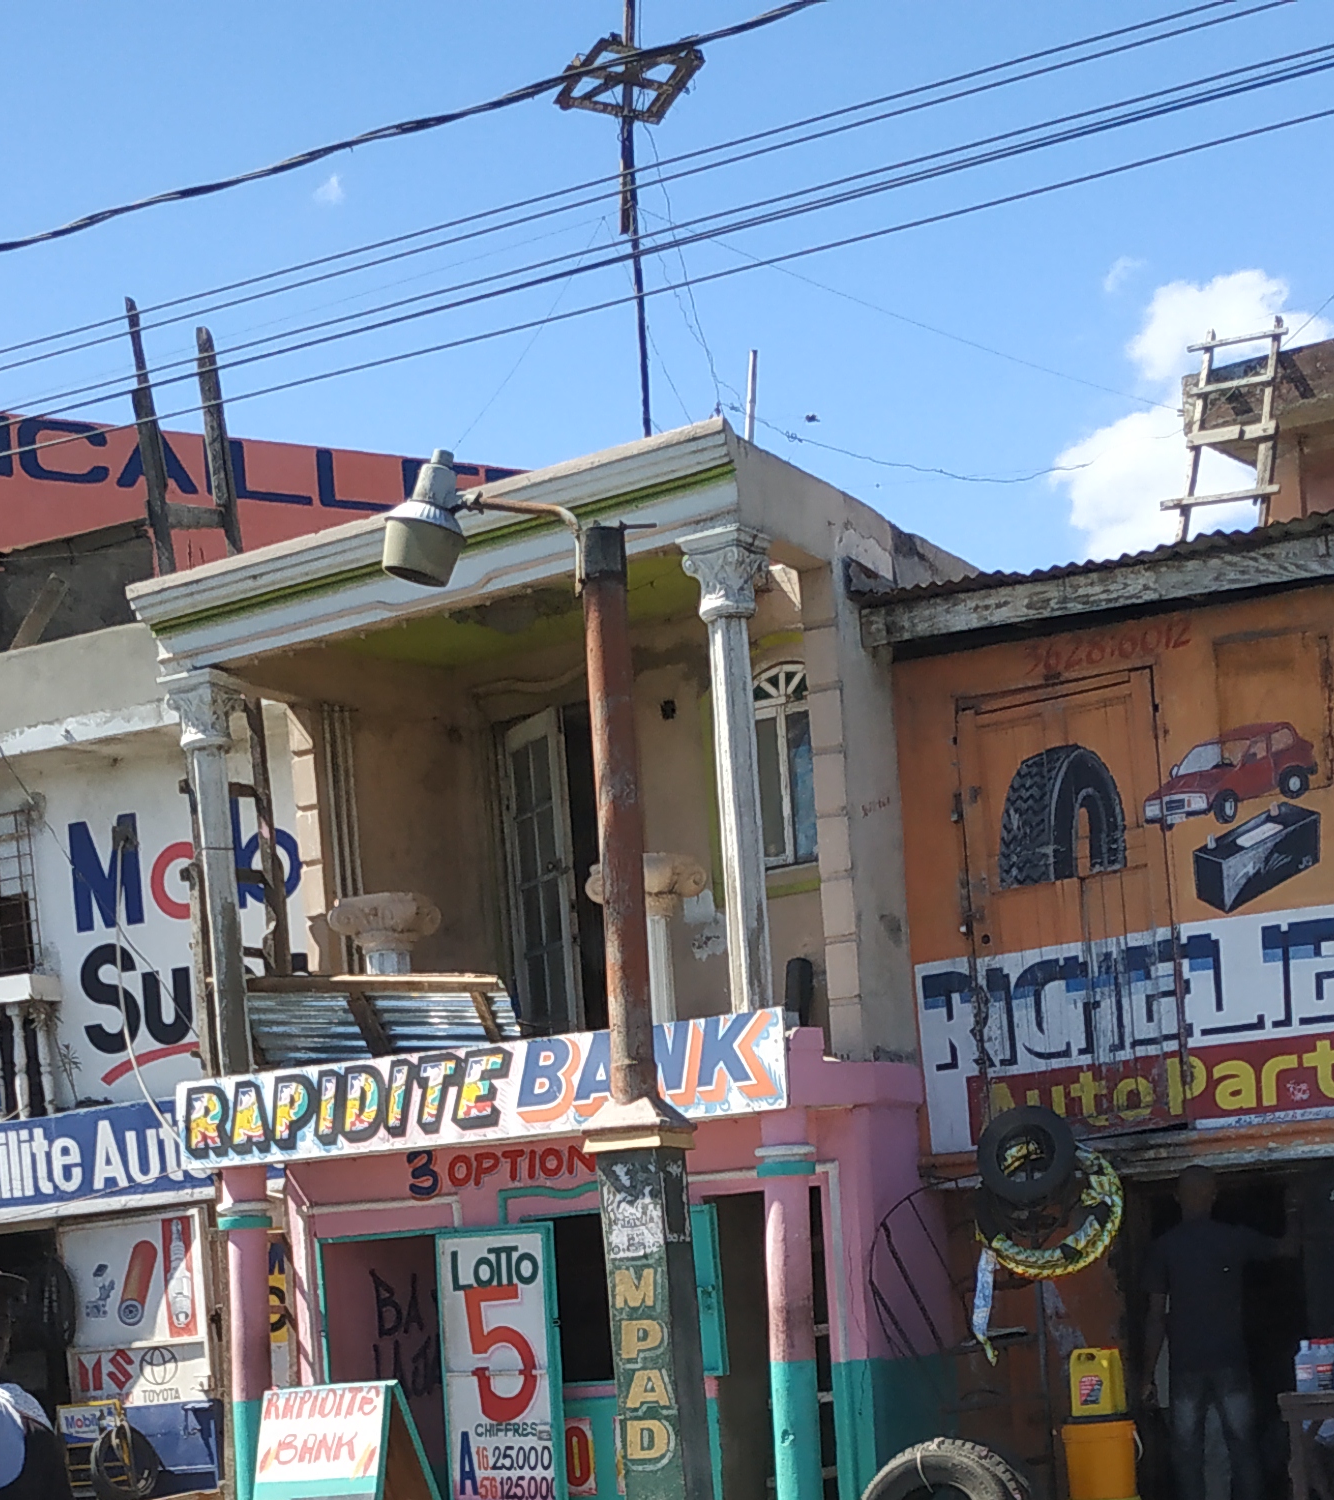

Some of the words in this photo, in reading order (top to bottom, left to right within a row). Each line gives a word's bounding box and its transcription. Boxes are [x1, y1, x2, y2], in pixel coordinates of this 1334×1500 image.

[184, 1047, 511, 1160] RAPIDITE
[517, 1012, 779, 1124] BANK
[92, 1112, 213, 1191] Aut
[406, 1149, 443, 1201] 3
[448, 1144, 597, 1189] OPTION
[463, 1282, 538, 1422] 5
[141, 1387, 181, 1403] TOYOTA
[274, 1431, 358, 1466] BANK
[474, 1421, 538, 1438] CHIFFRES
